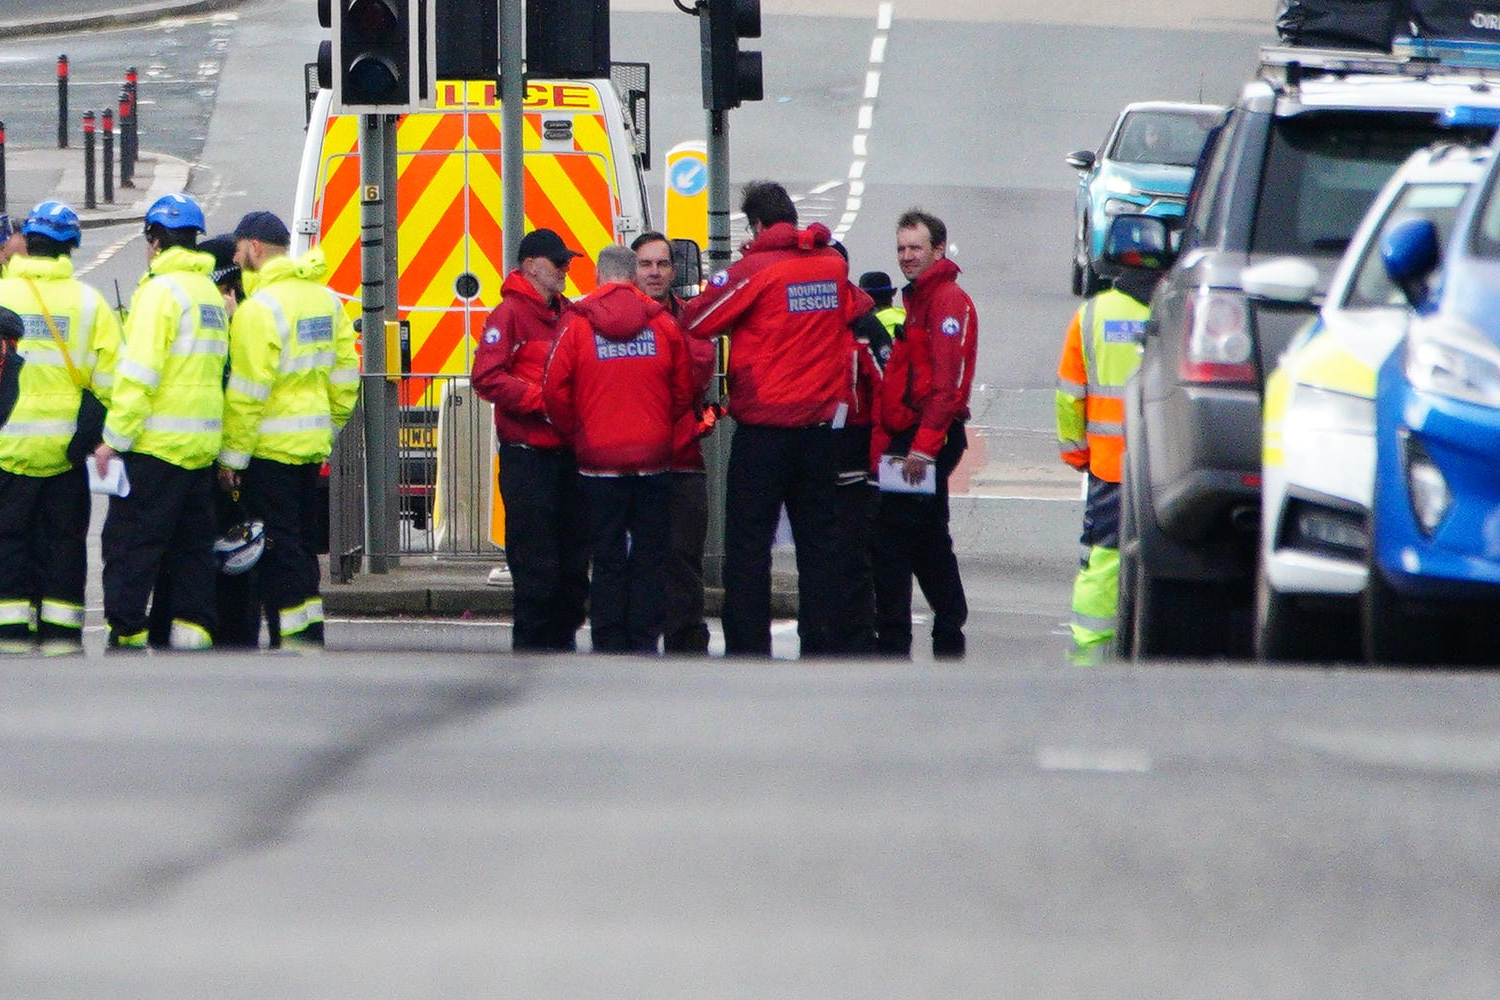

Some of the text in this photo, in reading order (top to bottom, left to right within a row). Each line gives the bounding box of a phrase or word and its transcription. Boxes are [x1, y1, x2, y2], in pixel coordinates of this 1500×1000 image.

[435, 85, 591, 108] LICE
[366, 186, 378, 200] 6
[788, 282, 838, 298] MOUNTAIN
[789, 296, 840, 312] RESCUE
[597, 342, 657, 359] RESCUE
